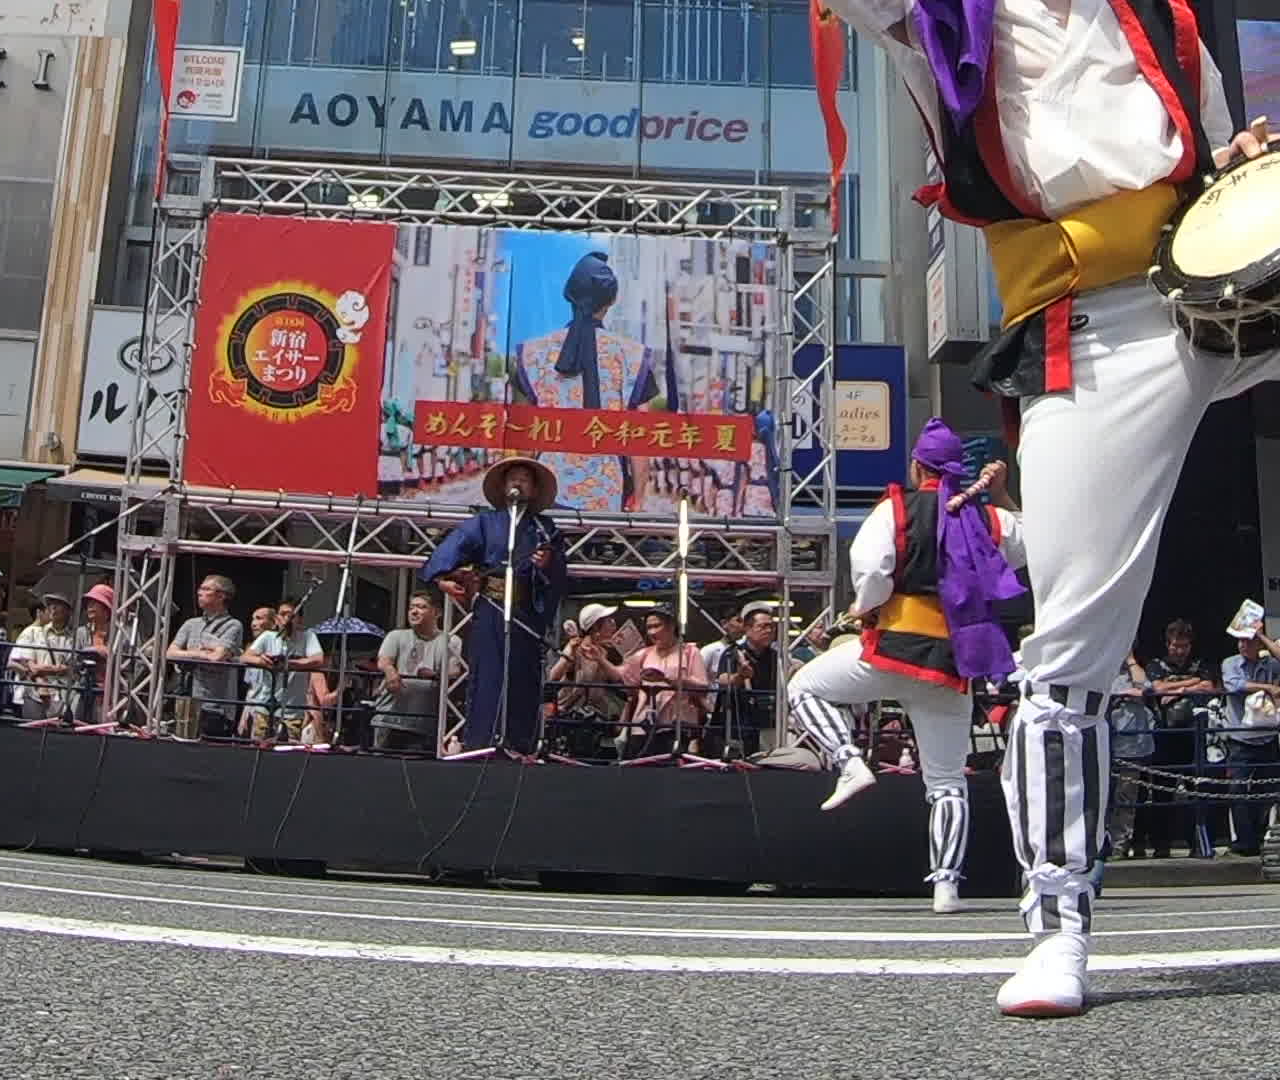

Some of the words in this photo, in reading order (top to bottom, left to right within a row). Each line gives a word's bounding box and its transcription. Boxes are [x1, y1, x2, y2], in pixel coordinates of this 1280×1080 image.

[289, 93, 512, 134] AOYAMA
[271, 329, 307, 349] 新宿
[252, 349, 320, 365] エイサー
[261, 365, 307, 385] まつり
[839, 408, 881, 420] adies
[583, 416, 703, 451] 令和元年
[713, 424, 737, 452] 夏
